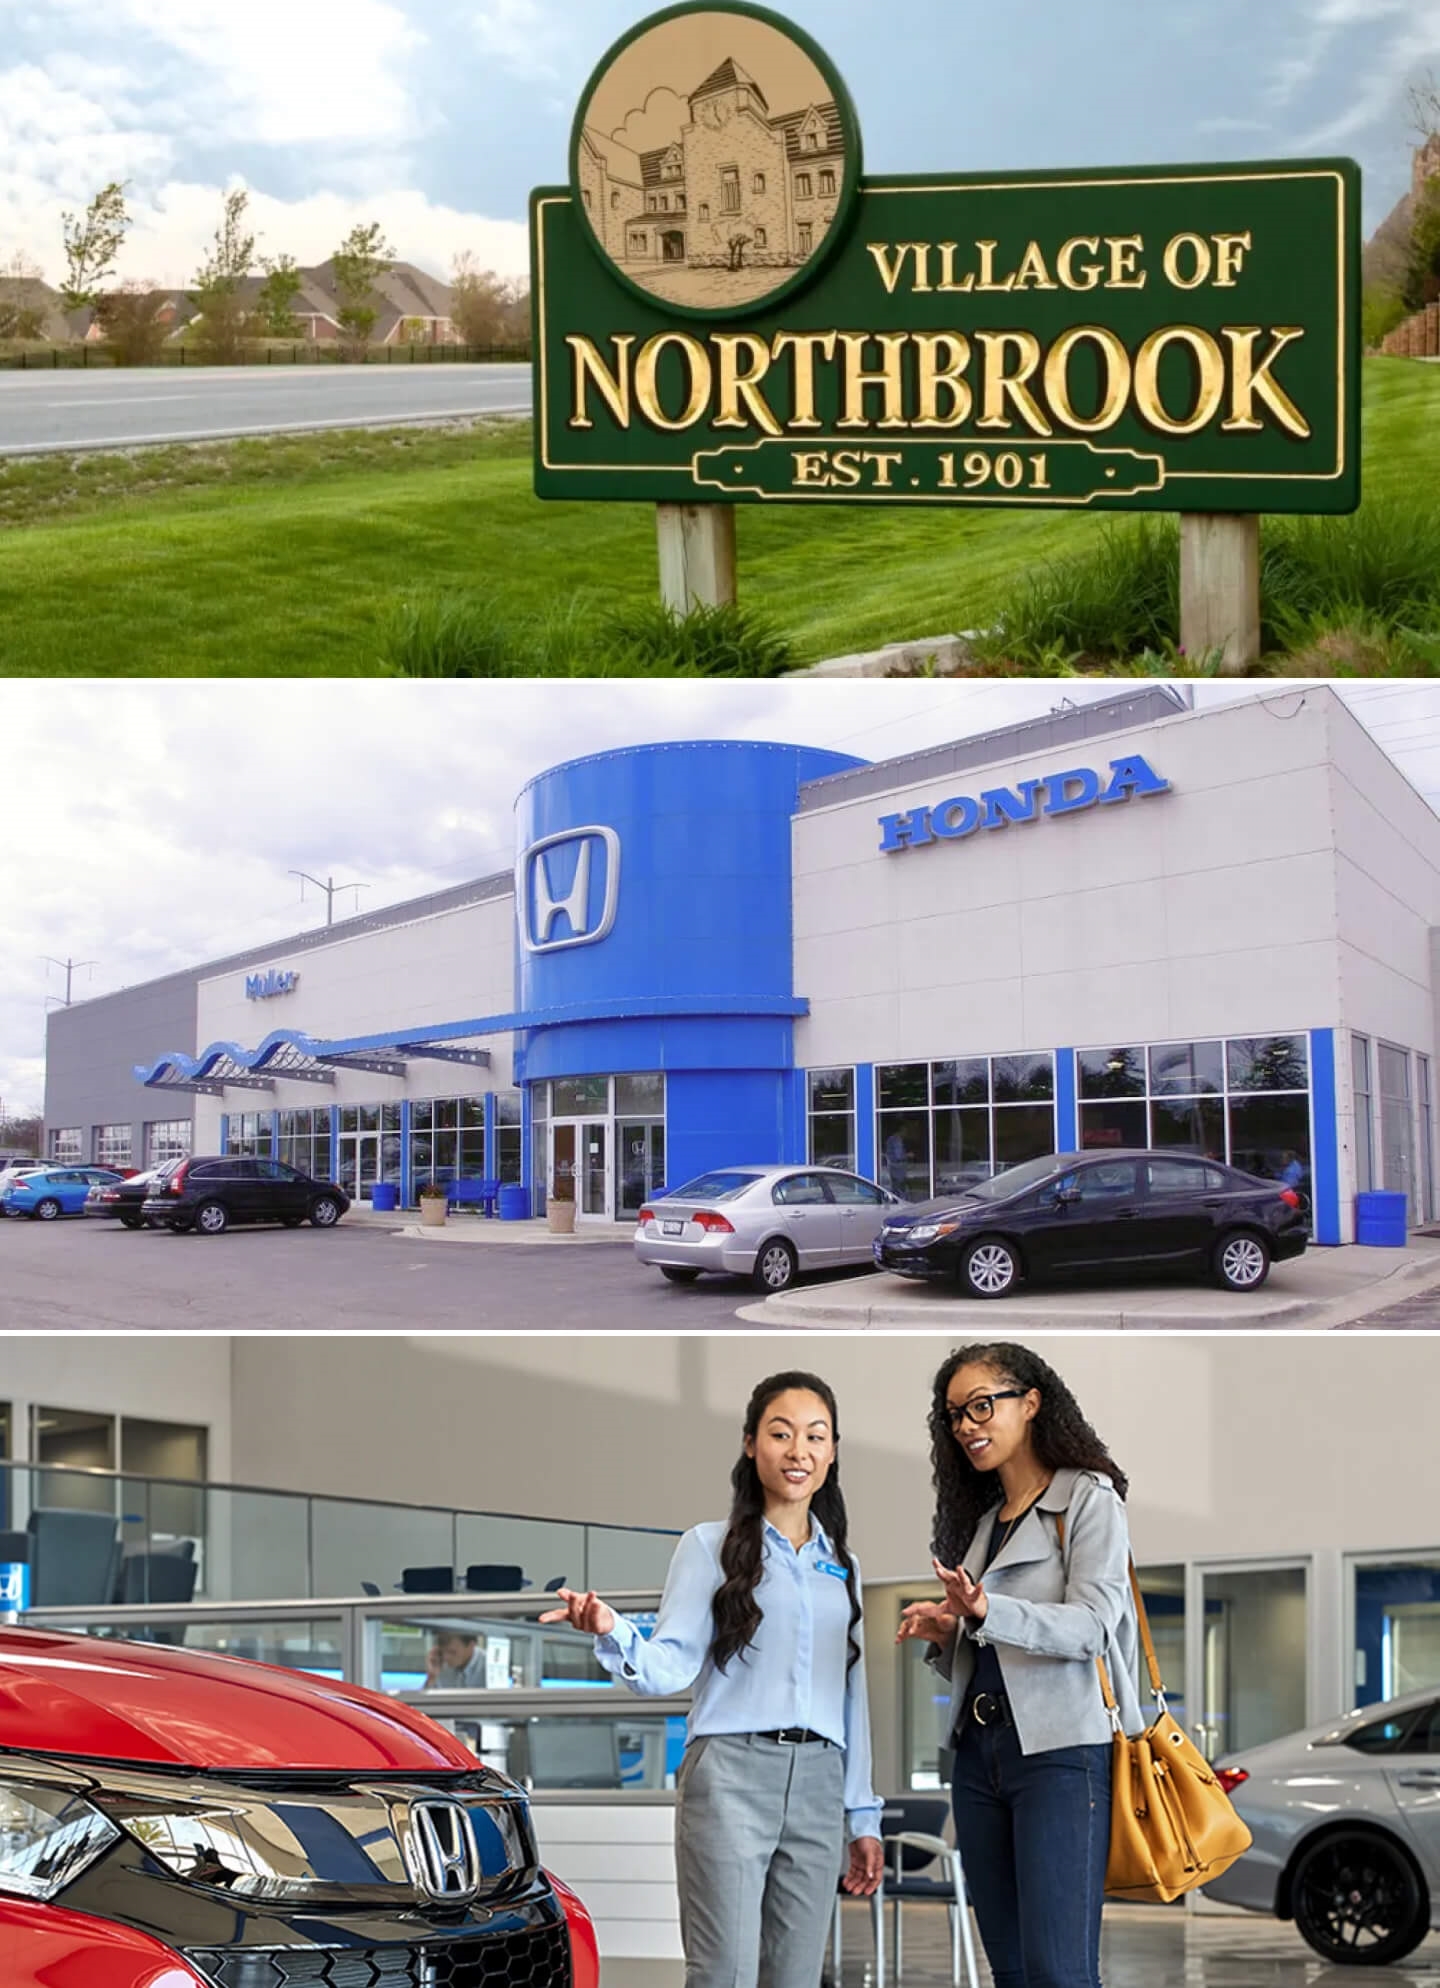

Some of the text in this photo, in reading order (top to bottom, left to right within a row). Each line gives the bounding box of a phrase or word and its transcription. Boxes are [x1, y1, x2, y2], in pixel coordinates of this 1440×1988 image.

[866, 230, 1253, 293] VILLAGE OF
[565, 325, 1311, 437] NORTHBROOK
[938, 452, 1052, 489] 1901
[878, 753, 1170, 854] HONDA
